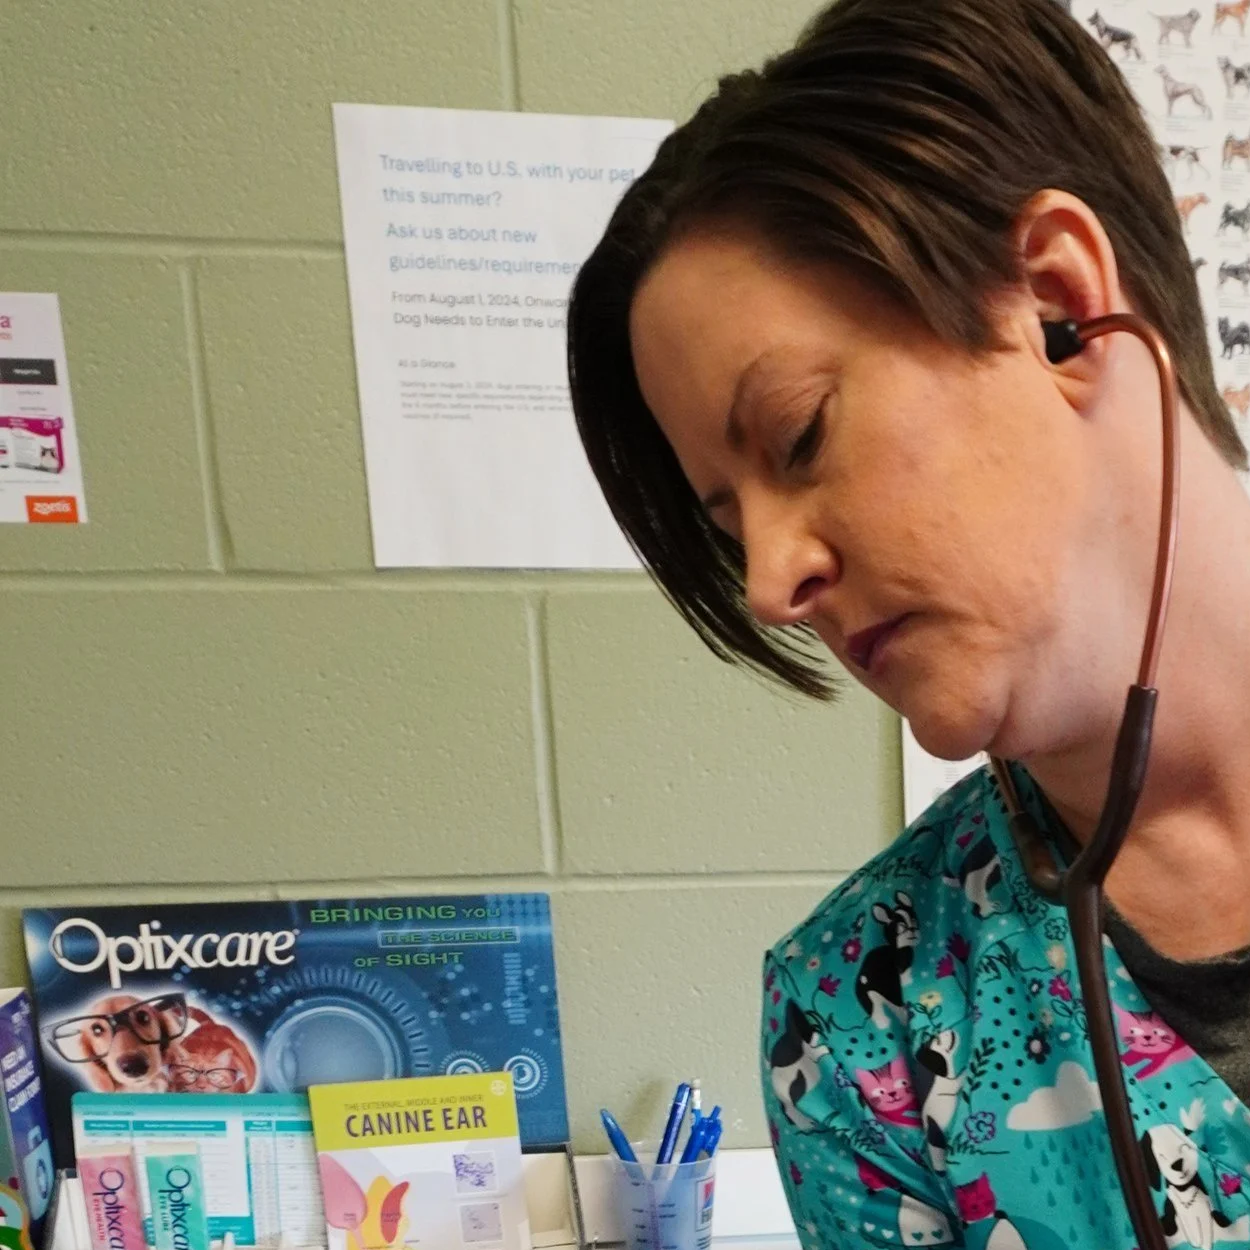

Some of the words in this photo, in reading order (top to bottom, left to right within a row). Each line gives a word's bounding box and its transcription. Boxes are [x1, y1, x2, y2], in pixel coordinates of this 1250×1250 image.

[379, 153, 463, 178] Travelling
[466, 160, 484, 177] to
[487, 160, 522, 177] U.S.
[526, 164, 563, 180] with
[567, 167, 604, 184] your
[382, 186, 416, 203] this
[419, 189, 503, 207] summer?
[386, 222, 417, 239] Ask
[421, 227, 443, 240] us
[447, 225, 499, 243] about
[501, 229, 538, 244] new
[389, 254, 579, 276] guidelines/requiremen
[391, 290, 426, 304] From
[429, 292, 476, 307] August
[393, 312, 422, 328] Dog
[424, 312, 466, 326] Needs
[469, 314, 483, 327] to
[486, 314, 519, 327] Enter
[523, 315, 545, 328] the
[310, 905, 457, 923] BRINGING
[384, 931, 423, 944] THE
[428, 930, 514, 943] SCIENCE
[51, 917, 298, 989] Optixcare
[354, 956, 380, 968] OF
[385, 951, 464, 967] SIGHT
[345, 1109, 436, 1138] CANINE
[441, 1106, 488, 1131] EAR
